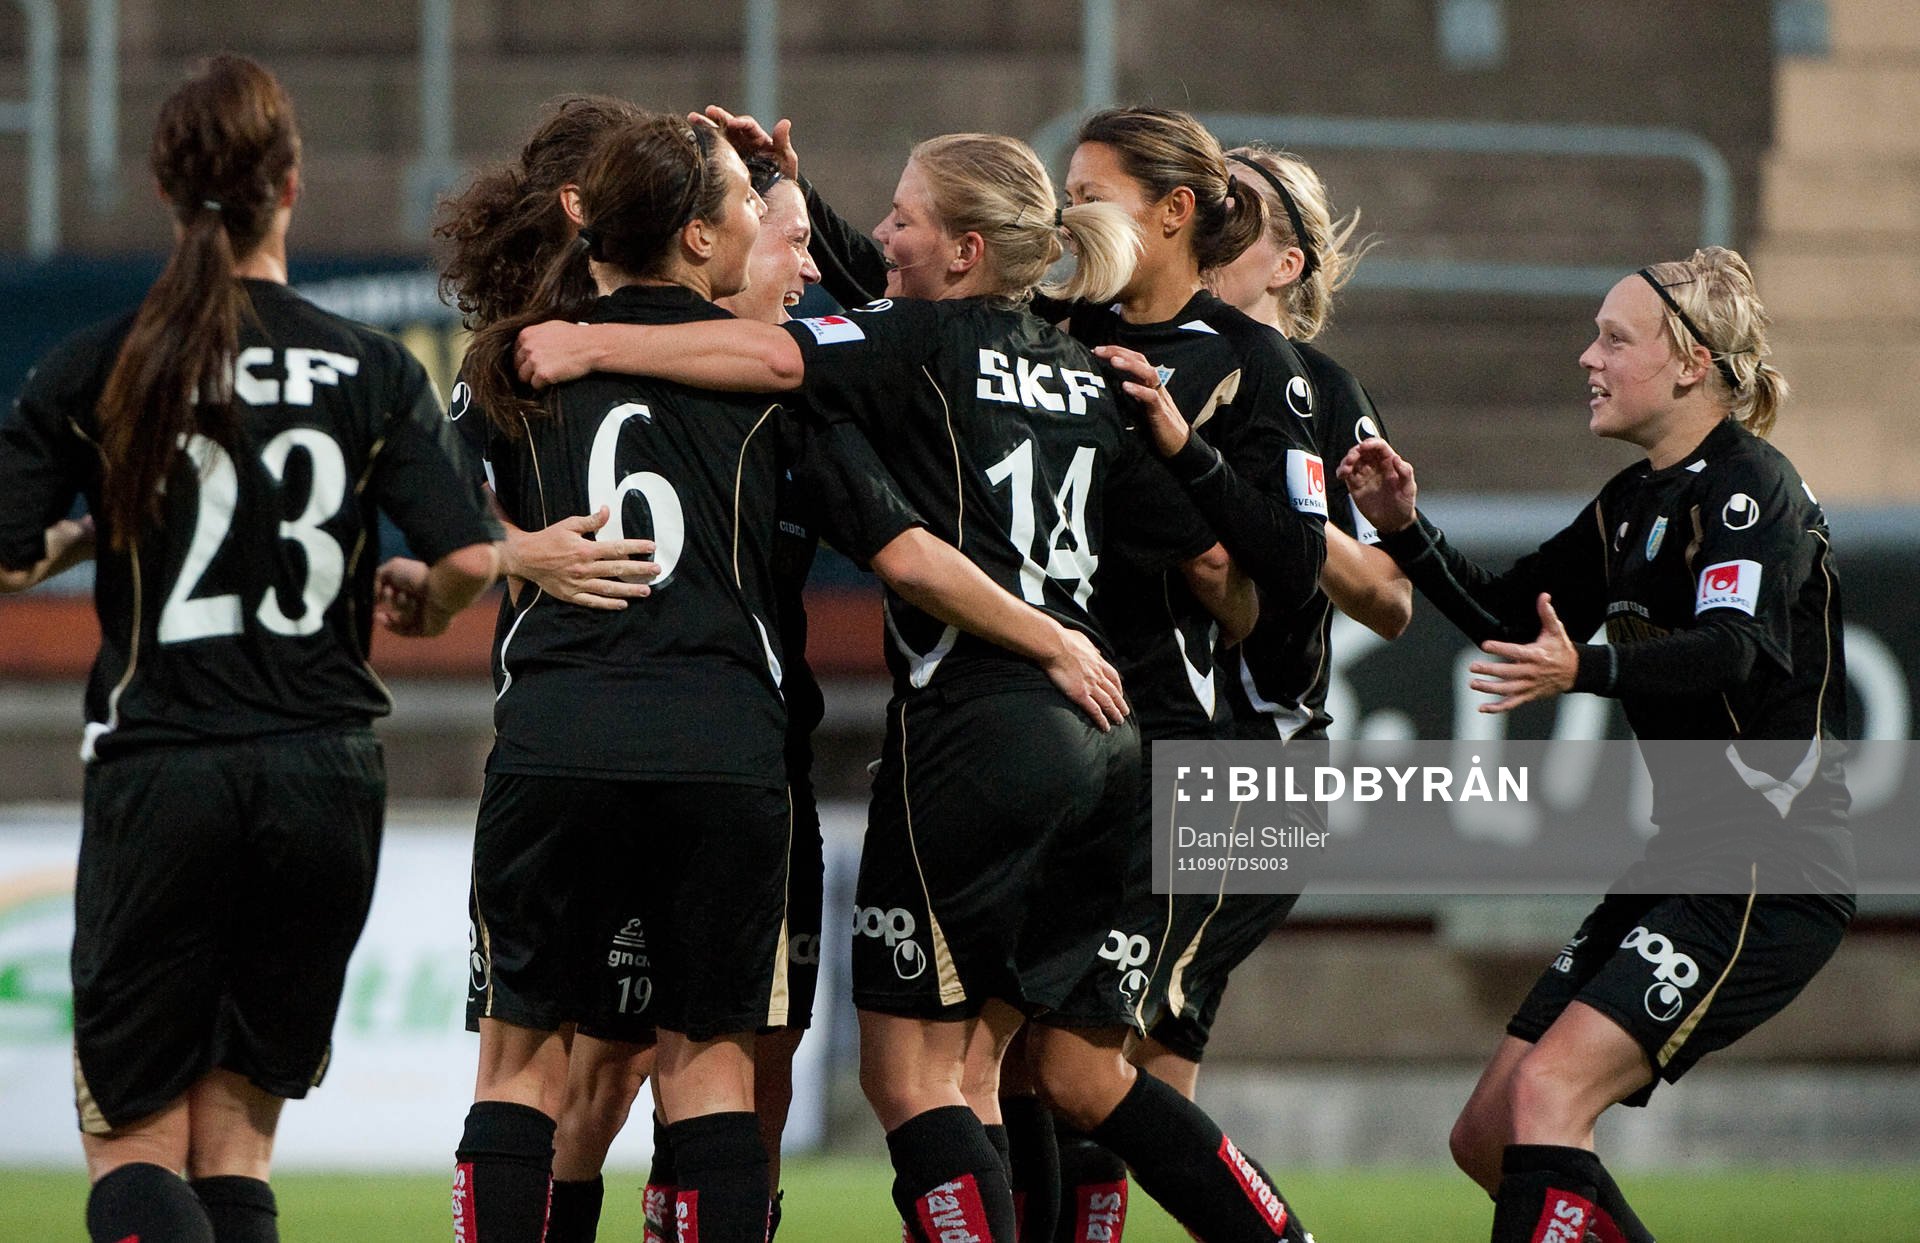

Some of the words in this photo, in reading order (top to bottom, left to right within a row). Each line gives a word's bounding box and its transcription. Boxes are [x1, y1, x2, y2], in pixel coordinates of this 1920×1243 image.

[976, 348, 1106, 416] SKF
[158, 427, 347, 643] 23
[588, 402, 685, 586] 6
[985, 438, 1099, 613] 14
[617, 976, 653, 1014] 19
